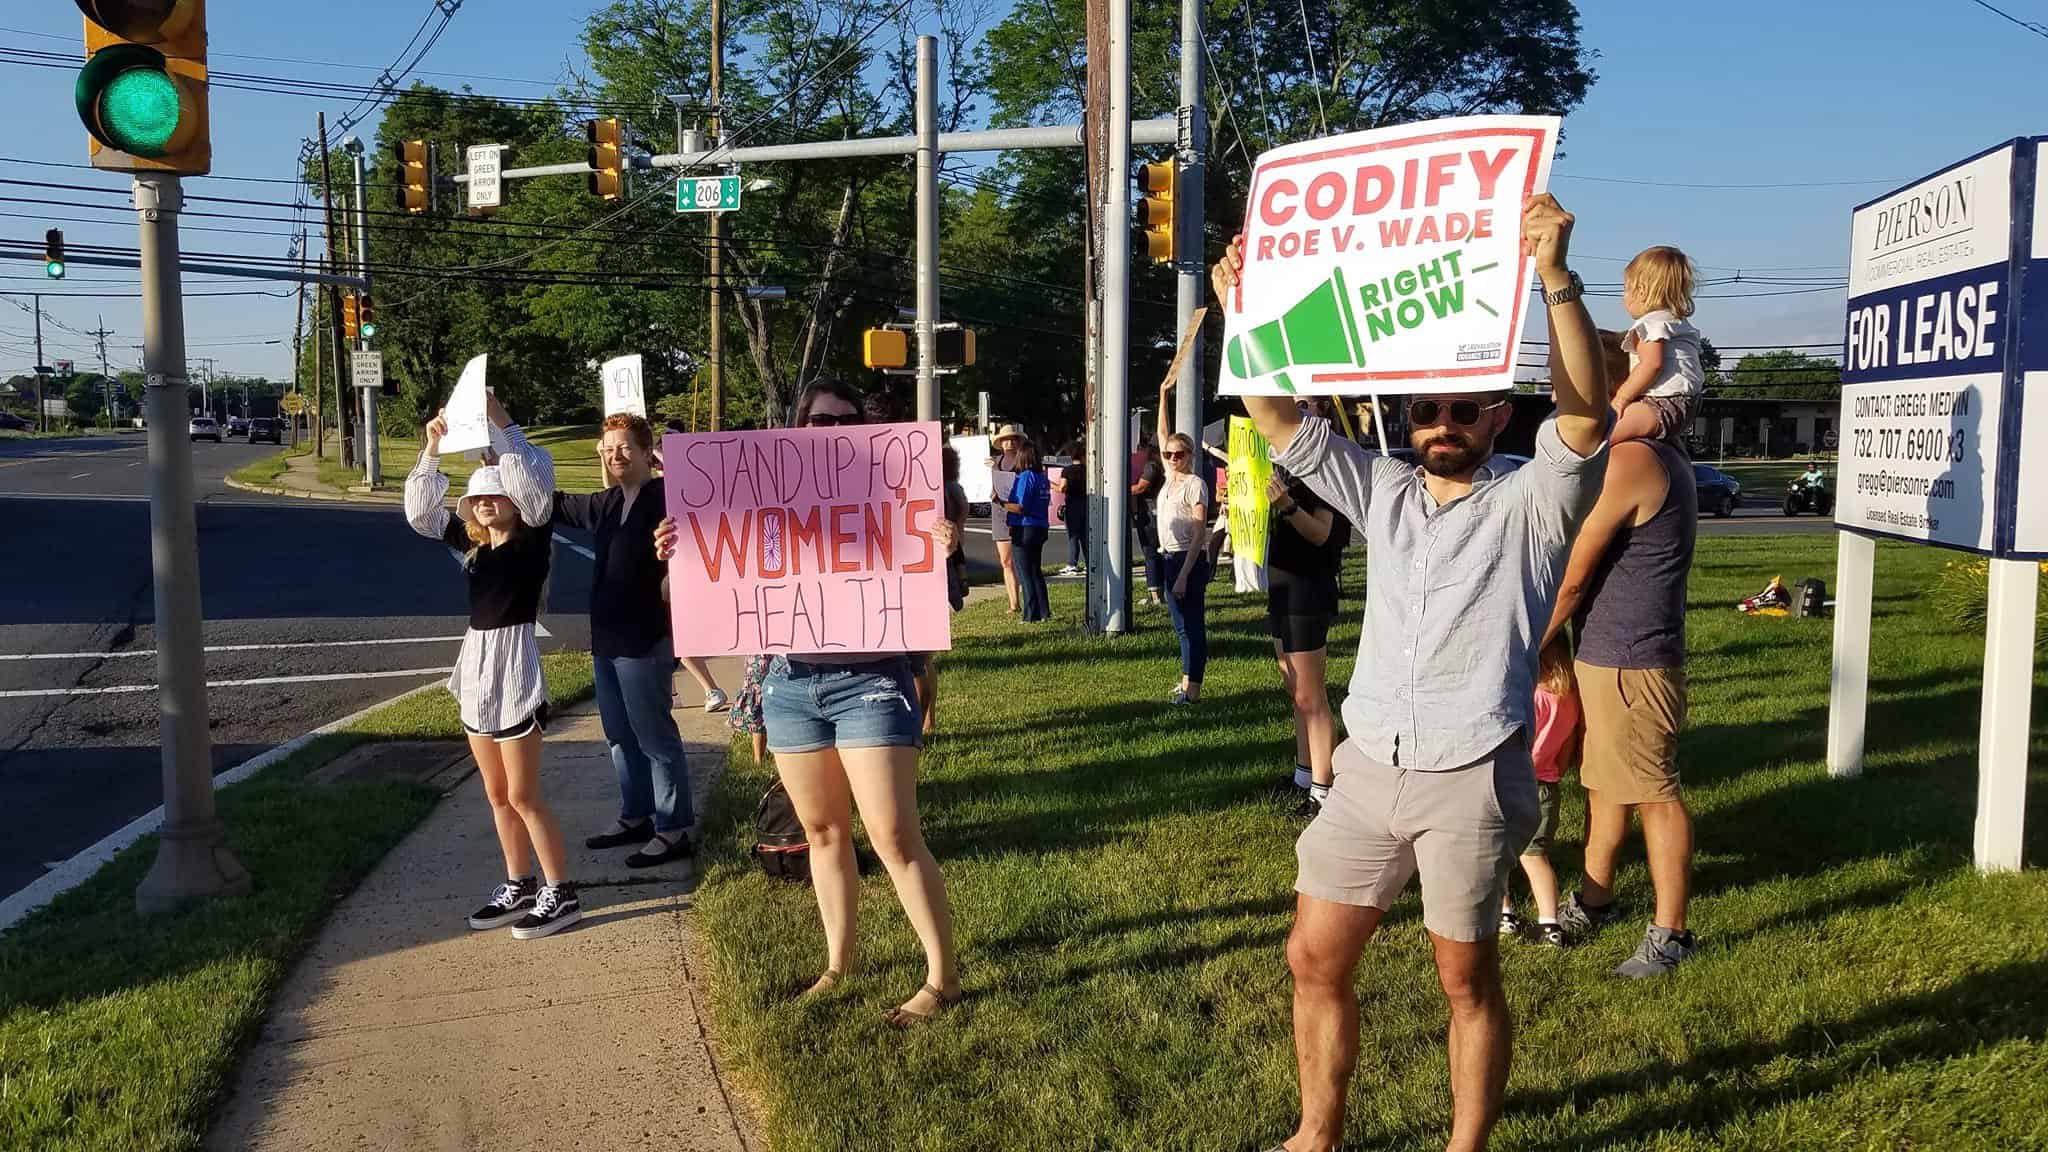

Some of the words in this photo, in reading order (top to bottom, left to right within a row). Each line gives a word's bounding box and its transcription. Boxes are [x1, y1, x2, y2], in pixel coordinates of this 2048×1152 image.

[470, 151, 487, 161] LEFT
[489, 150, 499, 160] ON
[473, 163, 496, 174] GREEN
[476, 191, 493, 201] ONLY
[683, 183, 689, 194] N
[697, 185, 720, 202] 206
[728, 181, 735, 193] S
[1259, 148, 1520, 227] CODIFY
[1873, 175, 1976, 251] PIERSON
[1257, 229, 1321, 262] ROE
[1331, 225, 1365, 253] V.
[1379, 208, 1494, 249] WADE
[1359, 249, 1463, 311] RIGHT
[1365, 280, 1466, 343] NOW
[1848, 304, 1891, 371] FOR
[1897, 281, 1999, 365] LEASE
[1855, 395, 1892, 418] CONTACT:
[1893, 392, 1927, 417] GREGG
[1928, 391, 1969, 417] MEDVIN
[681, 437, 802, 508] STAND
[812, 435, 855, 500] UP
[867, 428, 940, 498] FOR
[1854, 428, 1943, 461] 732.707.6900
[1946, 428, 1965, 463] x3
[1857, 469, 1955, 500] gregg@piersonre.com
[687, 488, 935, 583] WOMEN'S
[1866, 507, 1887, 524] Licensed
[1888, 510, 1899, 524] Real
[727, 576, 908, 652] HEALTH
